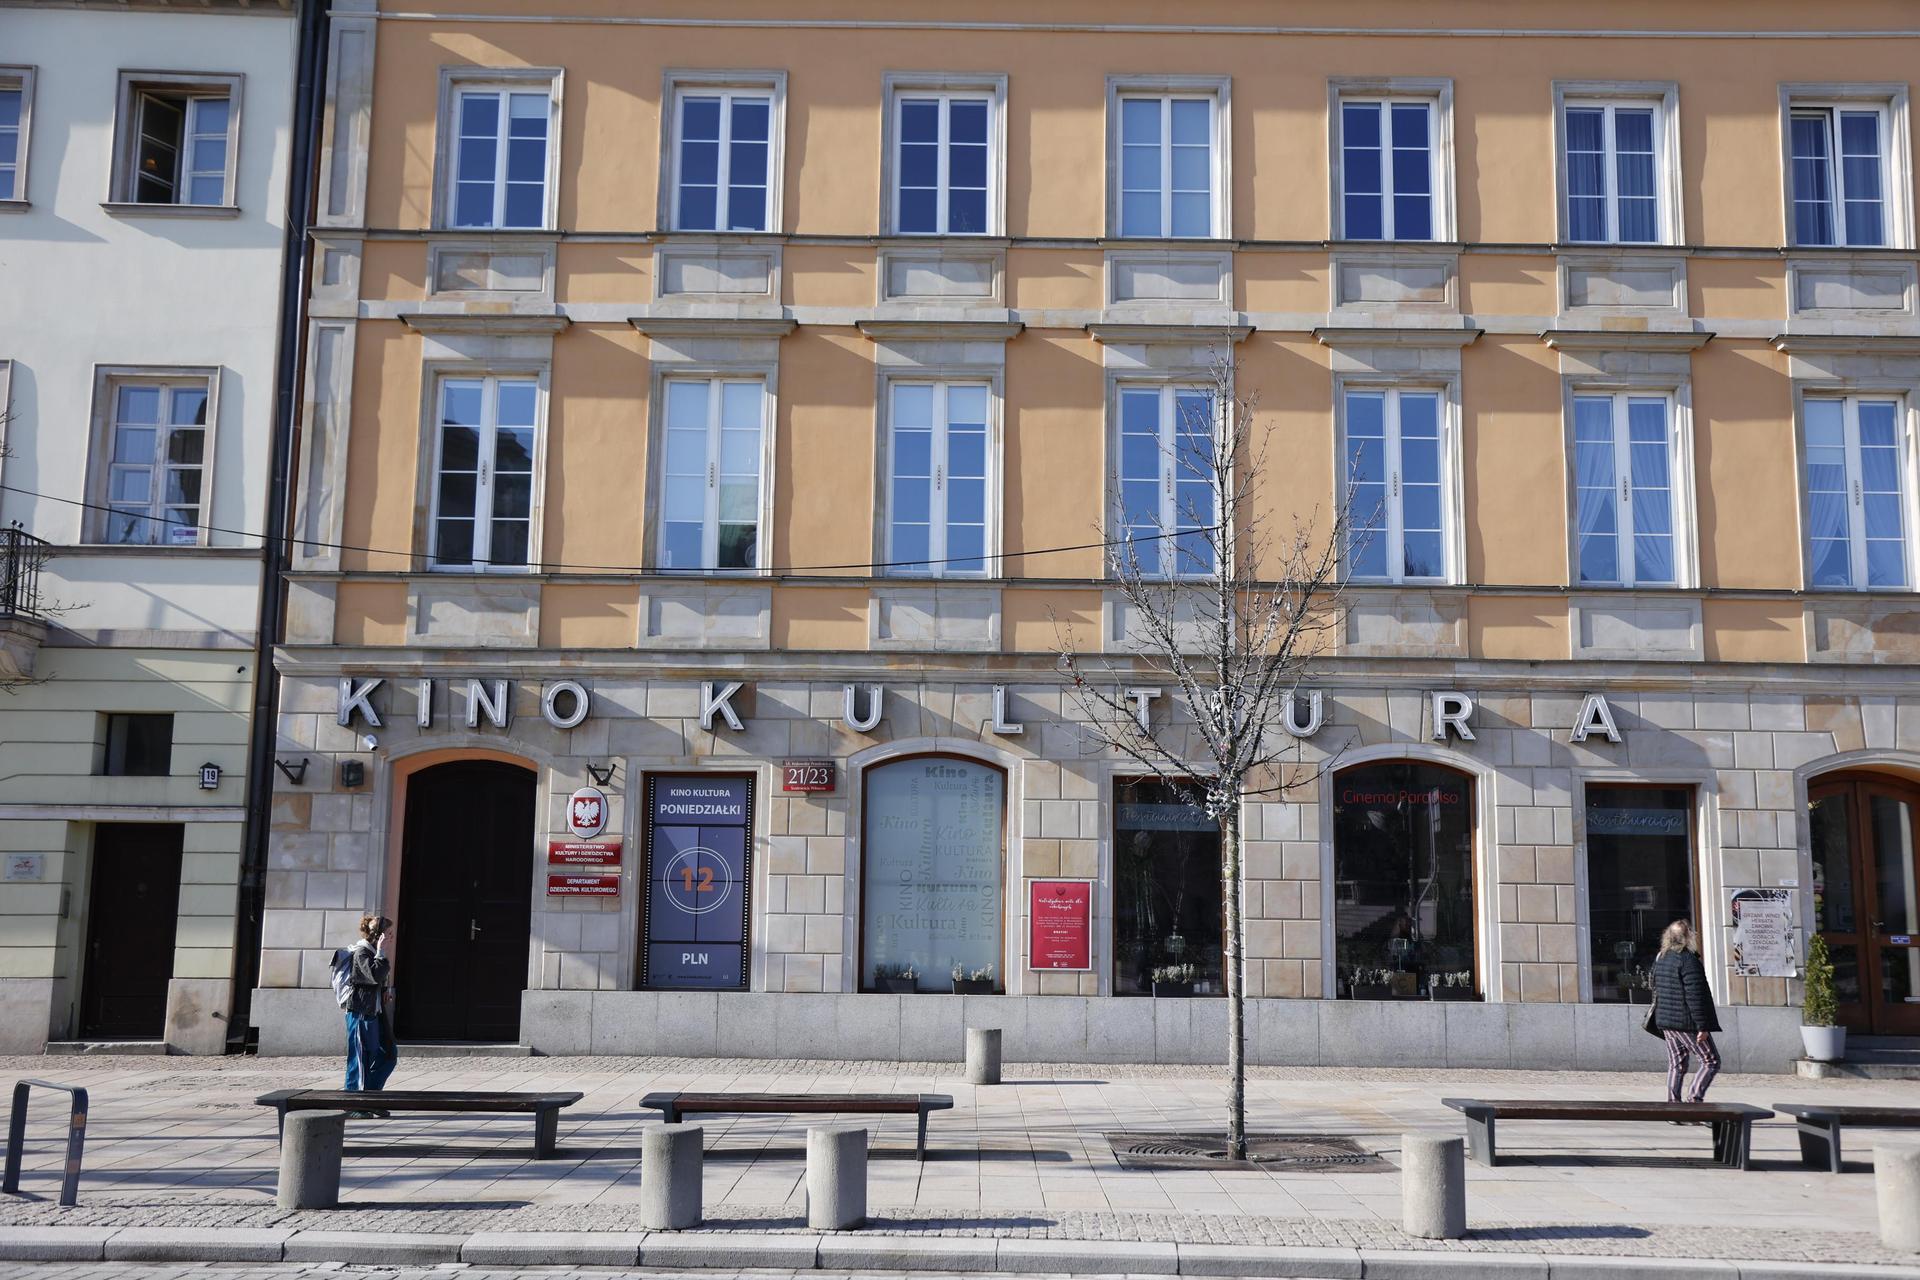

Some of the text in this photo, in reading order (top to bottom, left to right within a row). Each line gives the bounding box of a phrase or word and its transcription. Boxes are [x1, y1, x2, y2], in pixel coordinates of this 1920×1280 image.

[337, 678, 1622, 743] KINO KULTURA
[206, 770, 216, 780] 19
[788, 766, 828, 785] 21/23
[925, 766, 968, 778] Kino
[670, 789, 731, 797] KINO KULTURA
[934, 781, 968, 791] Kultura
[1343, 790, 1395, 804] Cinema
[660, 804, 741, 815] PONIEDZIAŁKI
[681, 867, 713, 892] 12
[900, 869, 913, 911] KINO
[981, 885, 994, 929] KINO
[890, 913, 957, 930] Kultura
[682, 953, 708, 965] PLN
